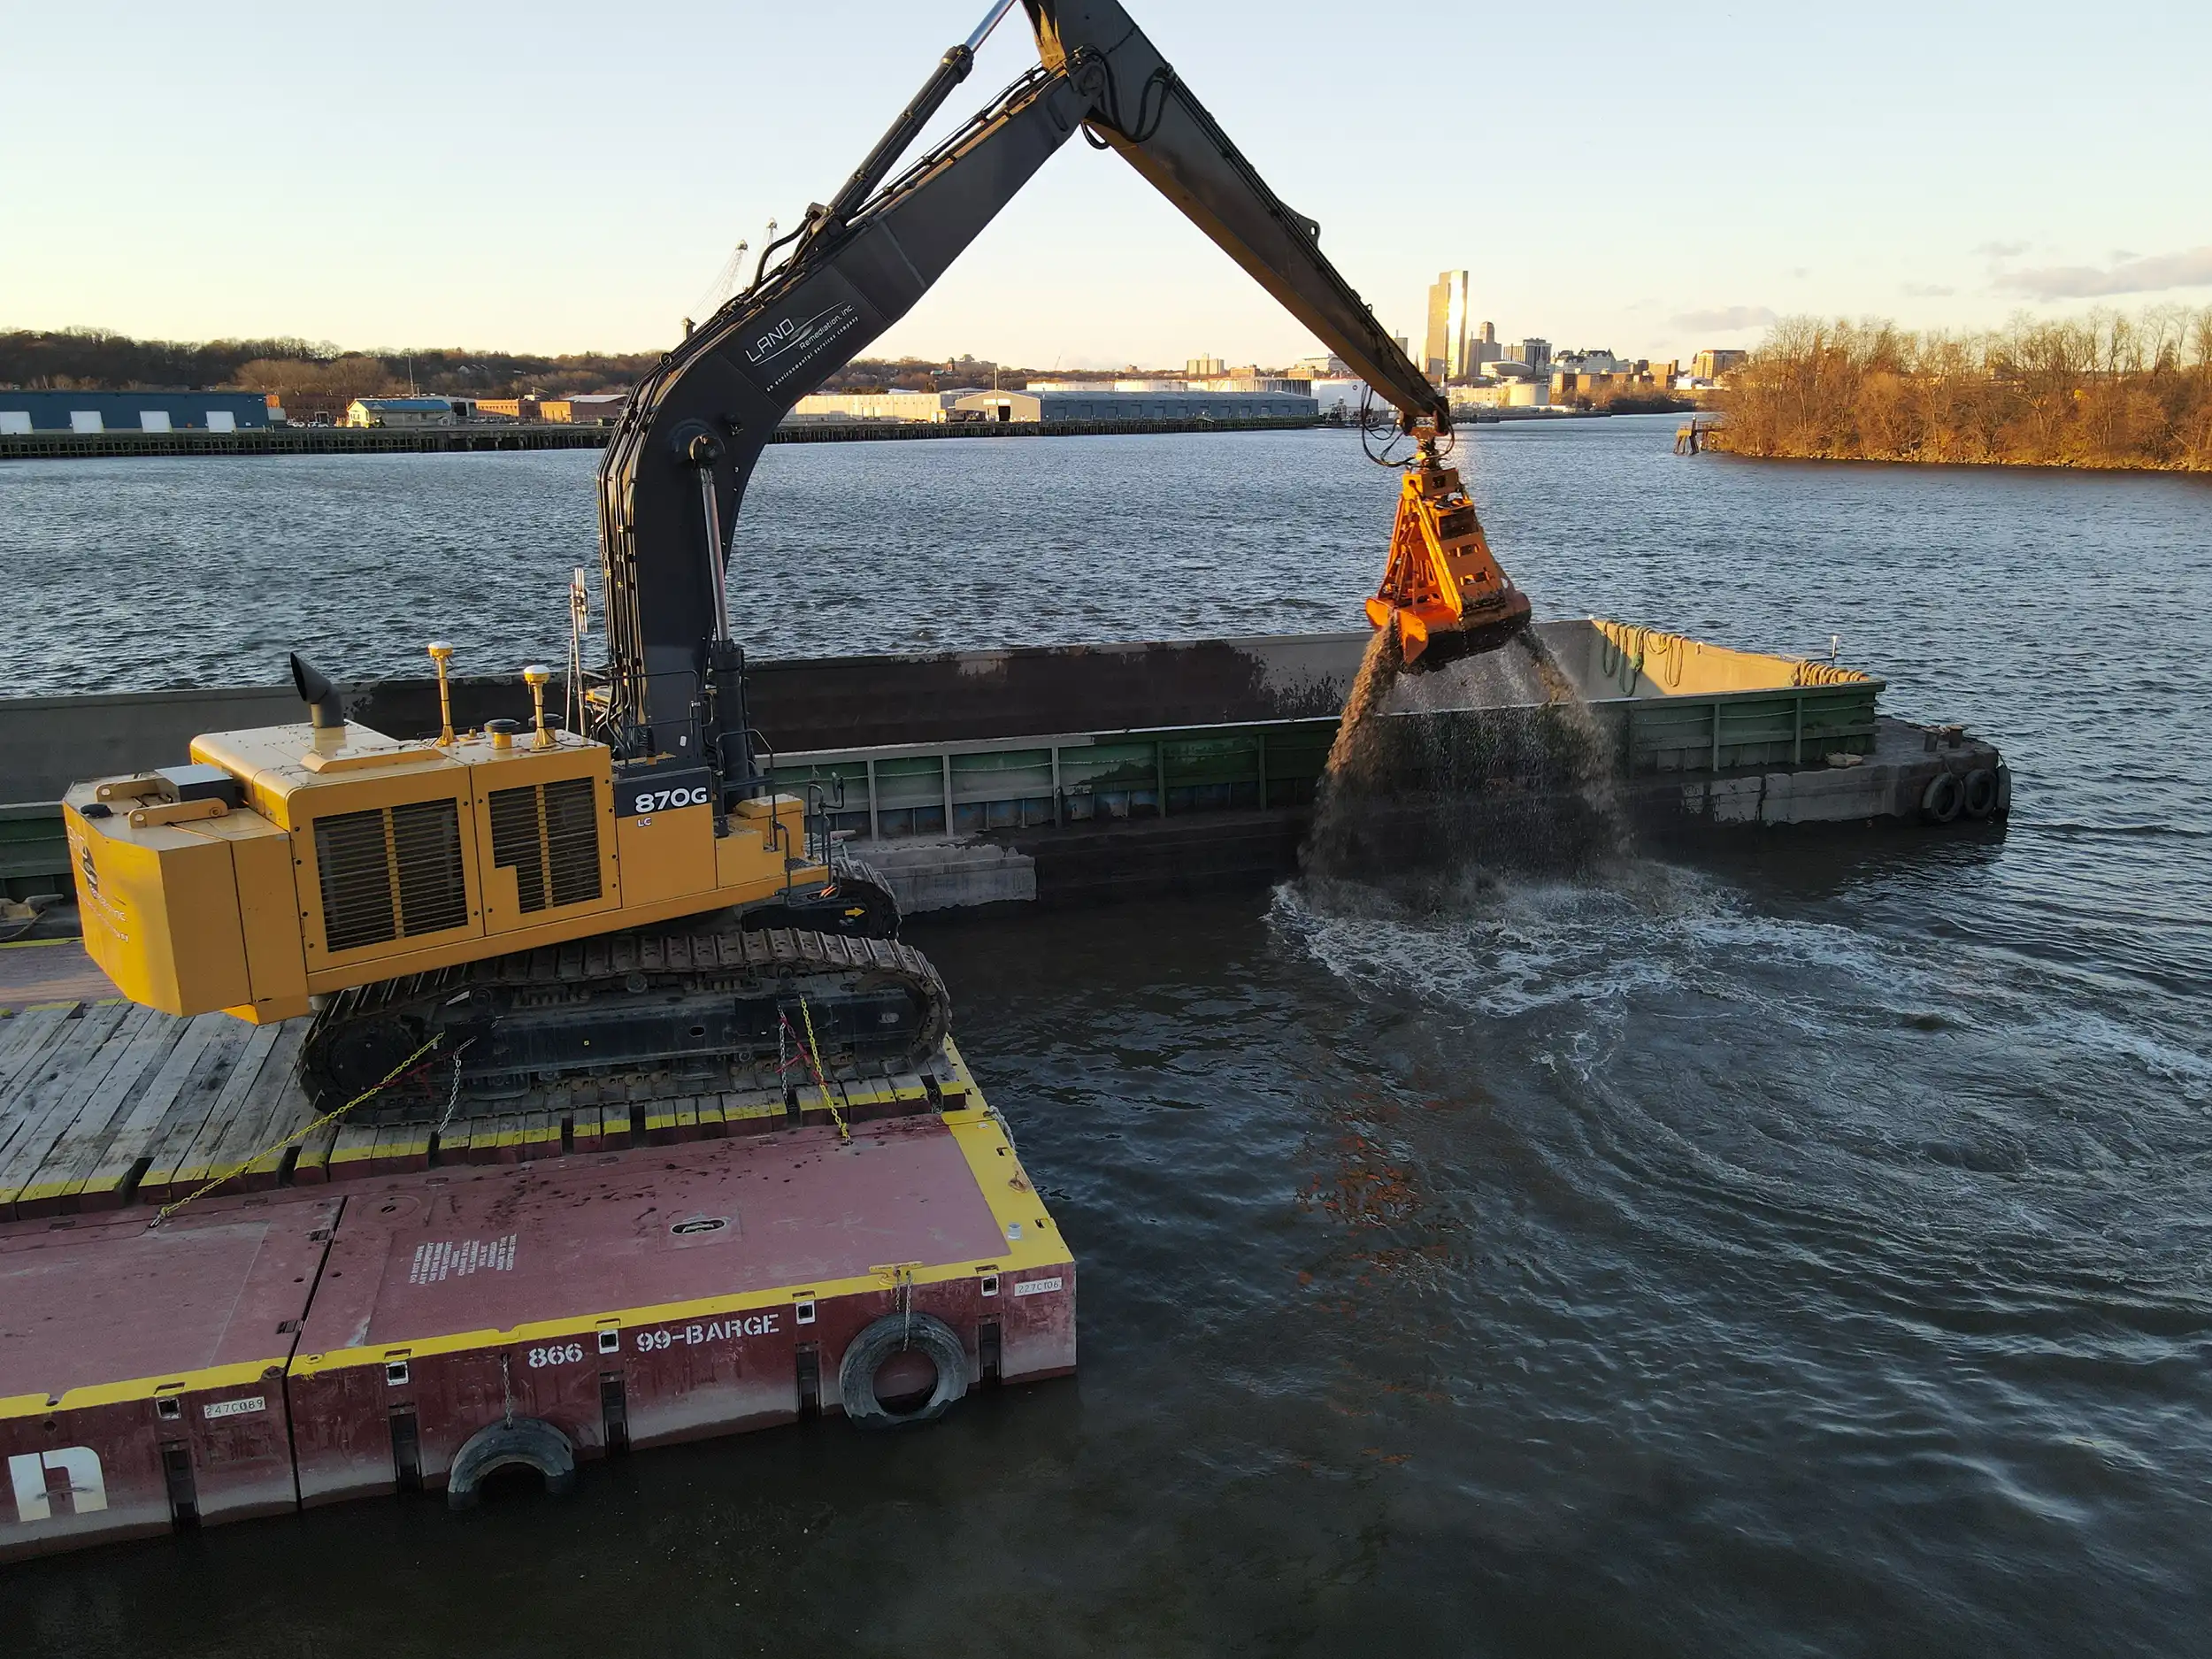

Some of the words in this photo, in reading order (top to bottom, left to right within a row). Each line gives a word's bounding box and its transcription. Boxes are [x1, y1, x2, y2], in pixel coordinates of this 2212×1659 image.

[745, 318, 795, 363] LAND
[799, 315, 842, 350] Remediation,
[775, 352, 813, 386] environmental
[813, 334, 836, 355] services
[836, 316, 858, 336] company
[635, 787, 708, 813] 870G
[637, 818, 652, 827] LC
[636, 1313, 780, 1352] 99-BARGE
[527, 1342, 583, 1368] 866
